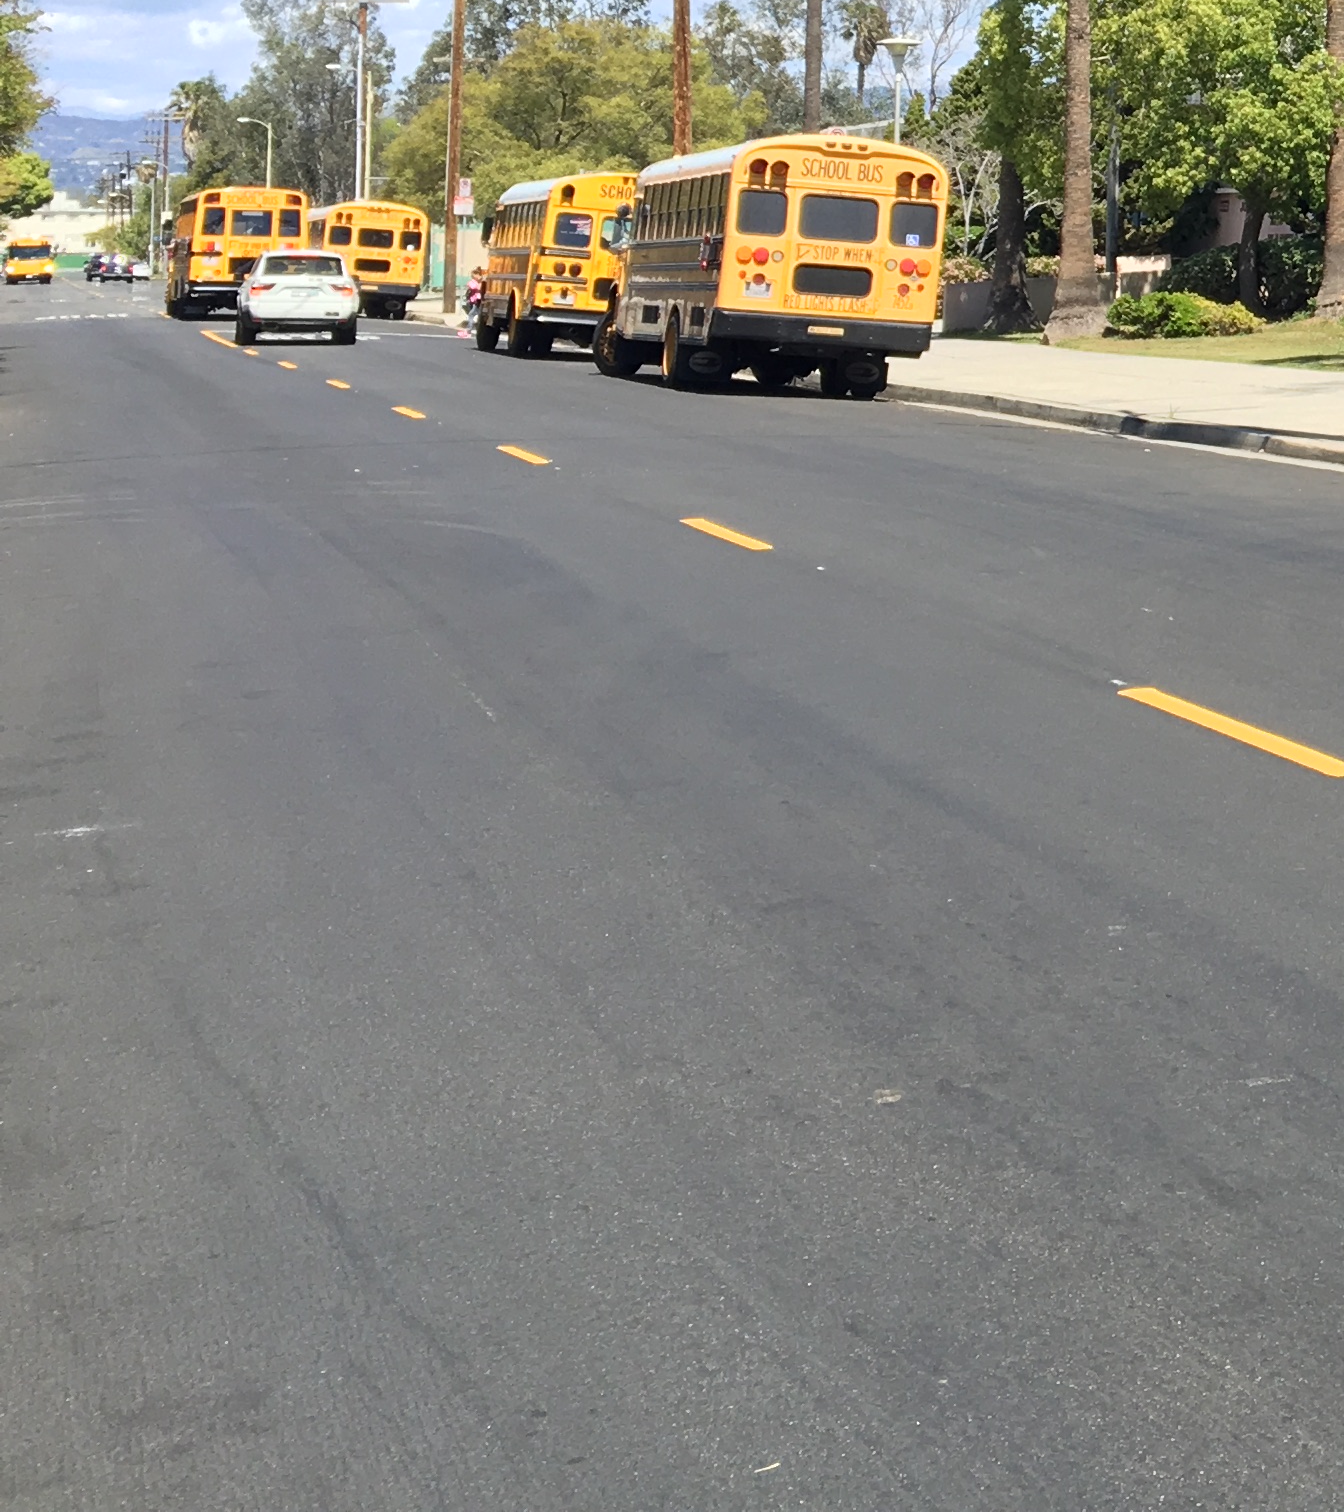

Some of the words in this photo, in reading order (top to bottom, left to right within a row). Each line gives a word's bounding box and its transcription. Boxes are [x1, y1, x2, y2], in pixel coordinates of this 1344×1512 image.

[801, 157, 852, 181] SCHOOL
[857, 163, 884, 183] BUS
[600, 183, 635, 200] SCHO
[812, 245, 839, 261] STOP
[843, 248, 872, 263] WHEN
[783, 294, 800, 309] RED
[804, 295, 834, 311] LIGHTS
[838, 297, 866, 313] FLASH
